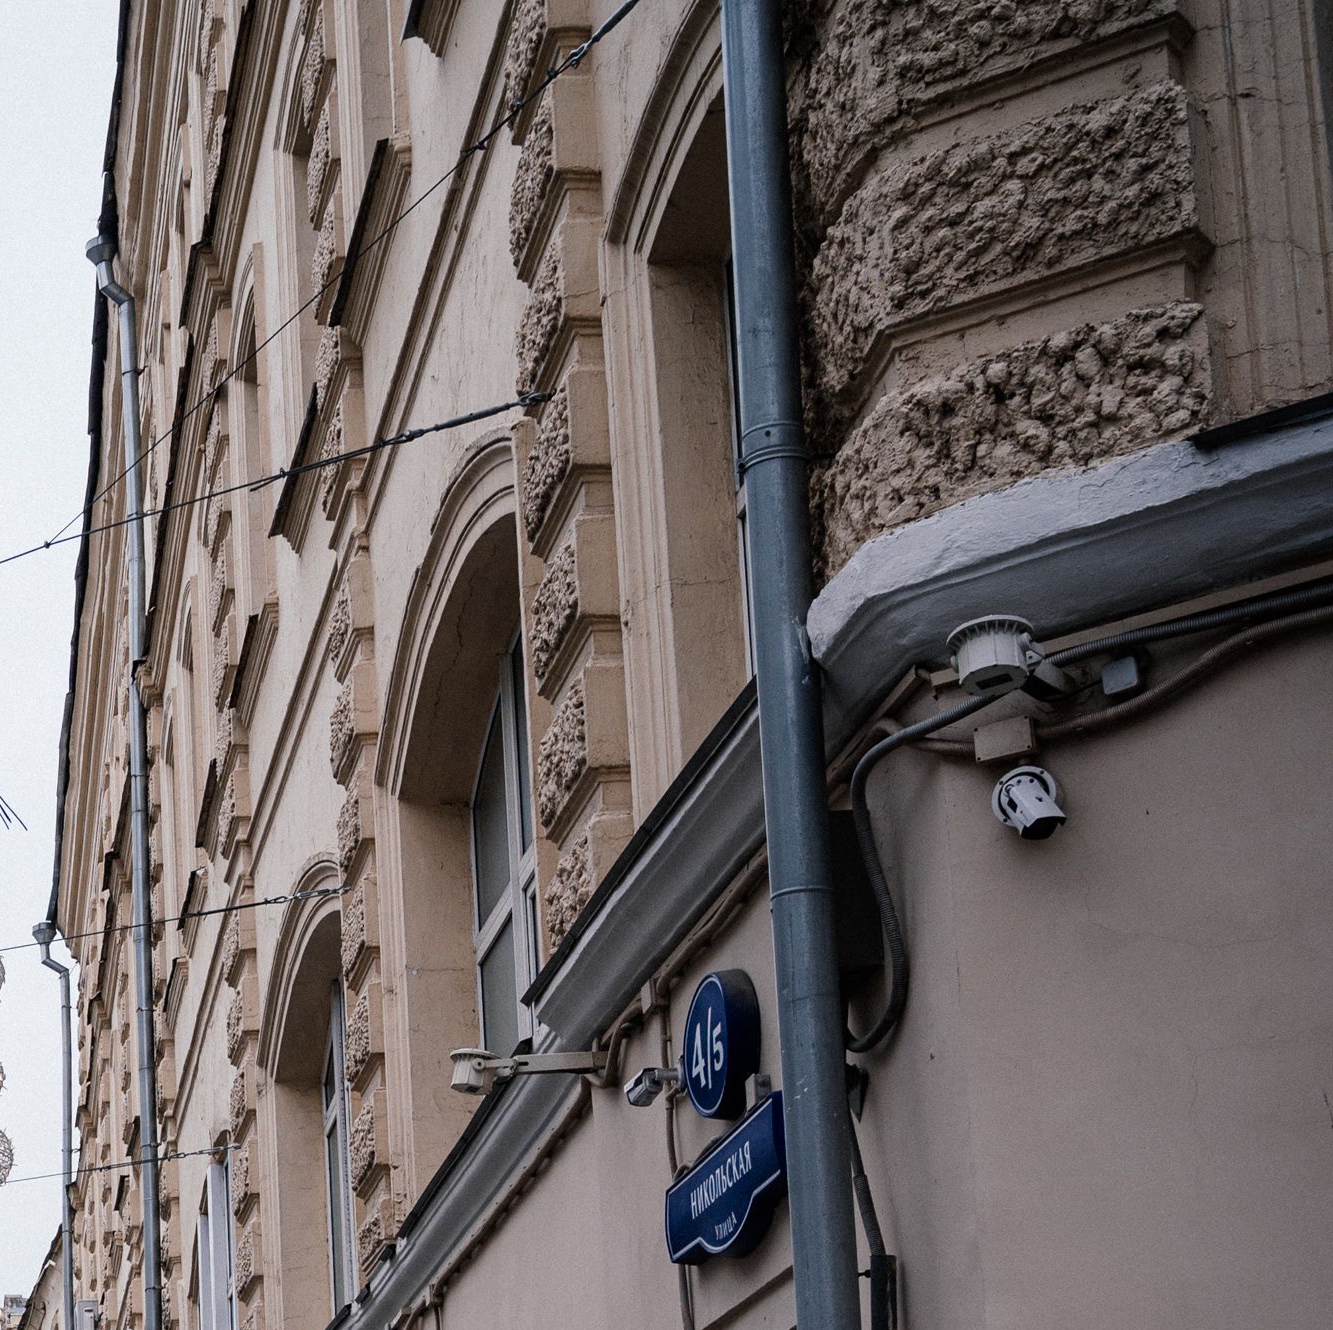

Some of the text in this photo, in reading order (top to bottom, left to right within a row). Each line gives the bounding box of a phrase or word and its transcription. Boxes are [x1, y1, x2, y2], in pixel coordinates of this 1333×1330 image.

[692, 1006, 724, 1090] 4/5
[690, 1140, 752, 1220] НИКОЛЬСКАЯ
[715, 1211, 737, 1240] УЛИЦА
